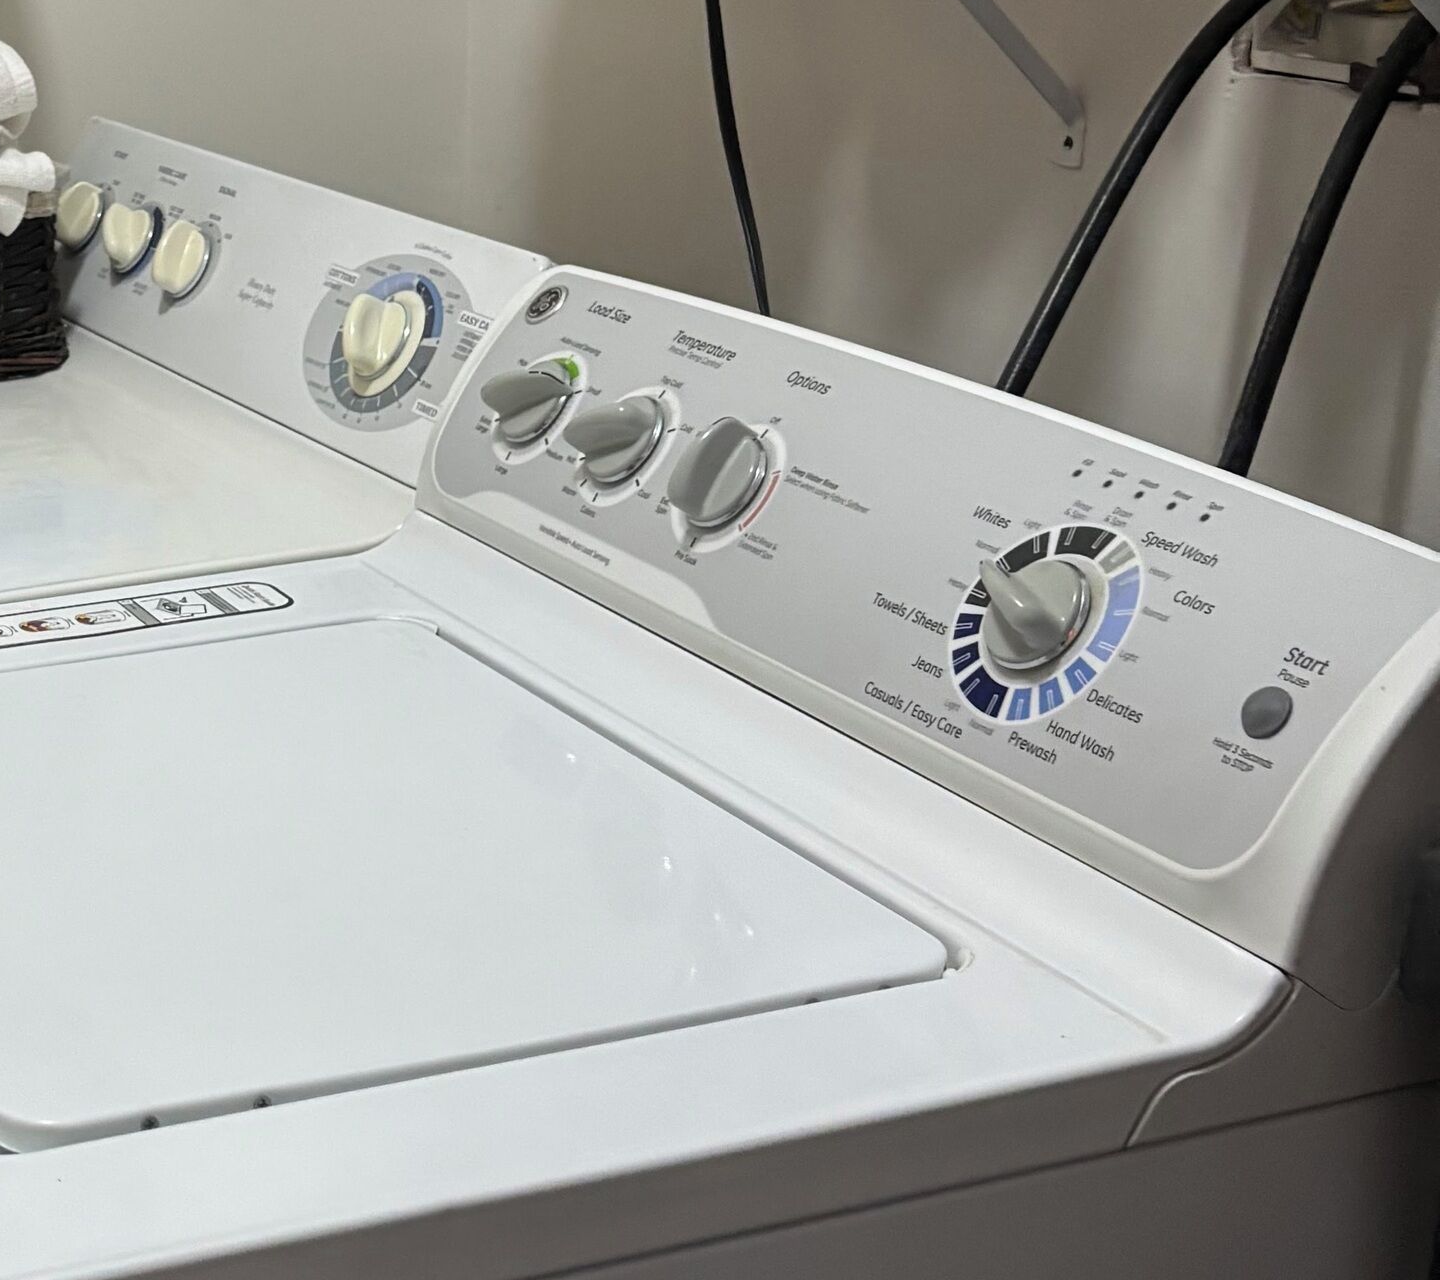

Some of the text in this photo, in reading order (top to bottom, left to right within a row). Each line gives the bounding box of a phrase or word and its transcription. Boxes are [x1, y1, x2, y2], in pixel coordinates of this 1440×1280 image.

[460, 313, 479, 327] EASY
[587, 300, 632, 324] Load Size
[671, 329, 737, 362] Temperature
[786, 370, 832, 395] Options
[971, 504, 1012, 529] Whites
[1141, 530, 1220, 568] Speed Wash
[872, 591, 908, 618] Towels
[911, 609, 948, 637] Sheets
[1172, 589, 1216, 616] Colors
[910, 655, 944, 679] Jeans
[1282, 646, 1331, 677] Start
[1276, 667, 1311, 689] Pause
[864, 680, 905, 711] Casuals
[910, 702, 937, 729] Easy
[935, 716, 964, 740] Care
[1086, 688, 1144, 725] Delicates
[1007, 730, 1058, 765] Prewash
[1045, 719, 1116, 762] Hand Wash
